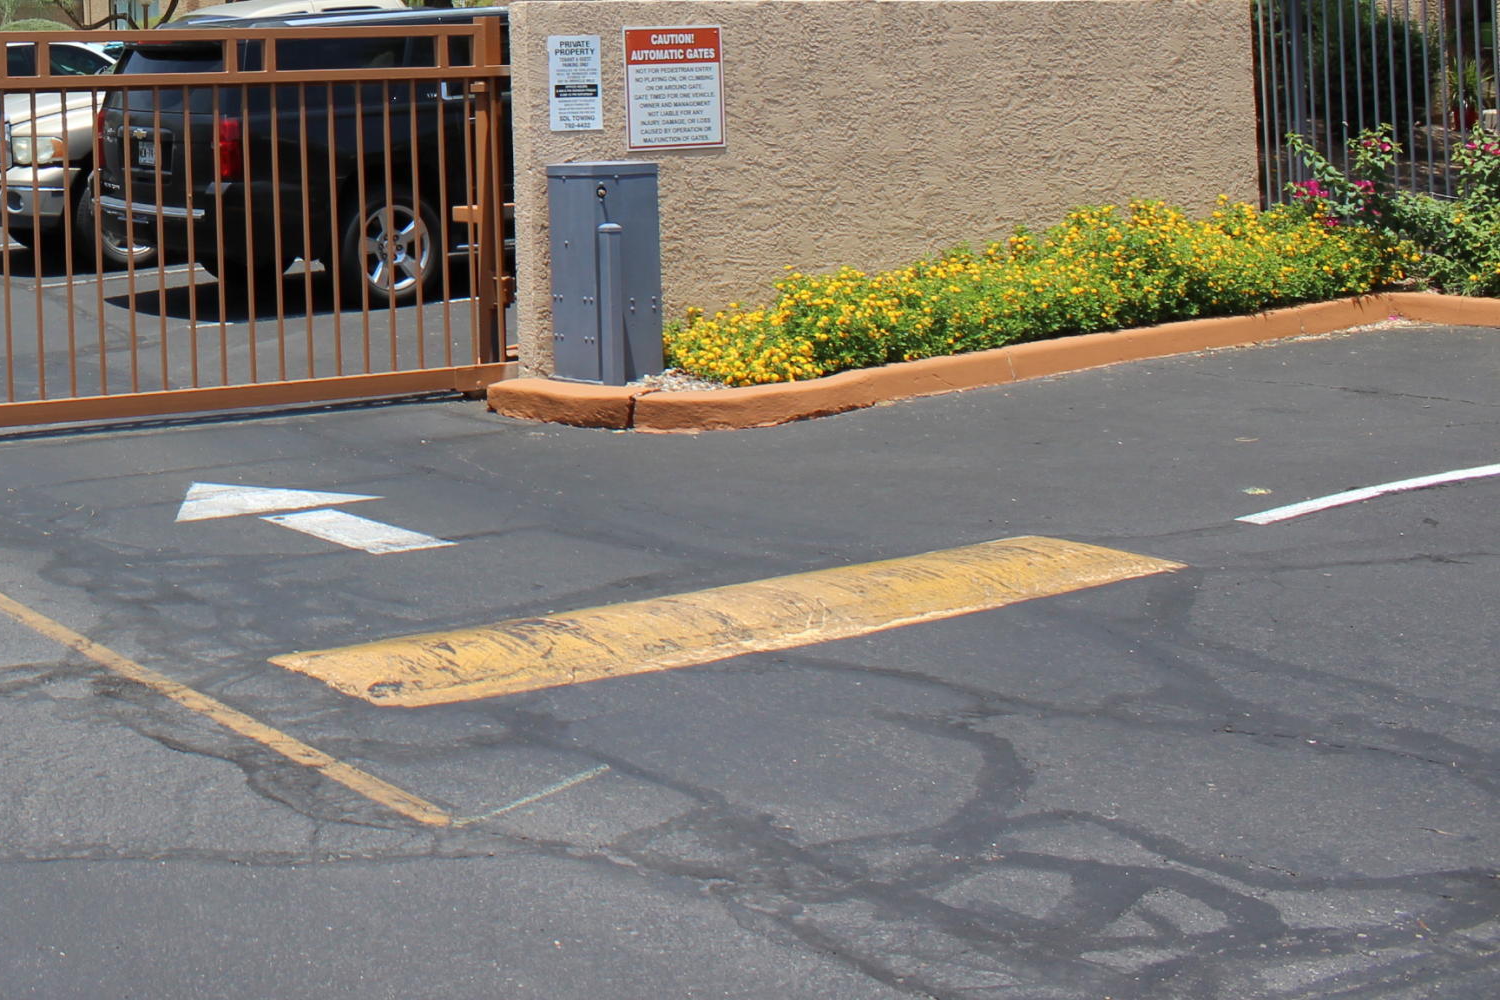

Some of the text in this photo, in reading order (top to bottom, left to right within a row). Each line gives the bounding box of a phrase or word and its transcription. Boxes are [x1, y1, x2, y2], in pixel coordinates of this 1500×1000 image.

[559, 40, 591, 48] PRIVATE
[650, 33, 695, 45] CAUTION!
[555, 48, 595, 56] PROPERTY
[631, 48, 715, 61] AUTOMATIC GATES
